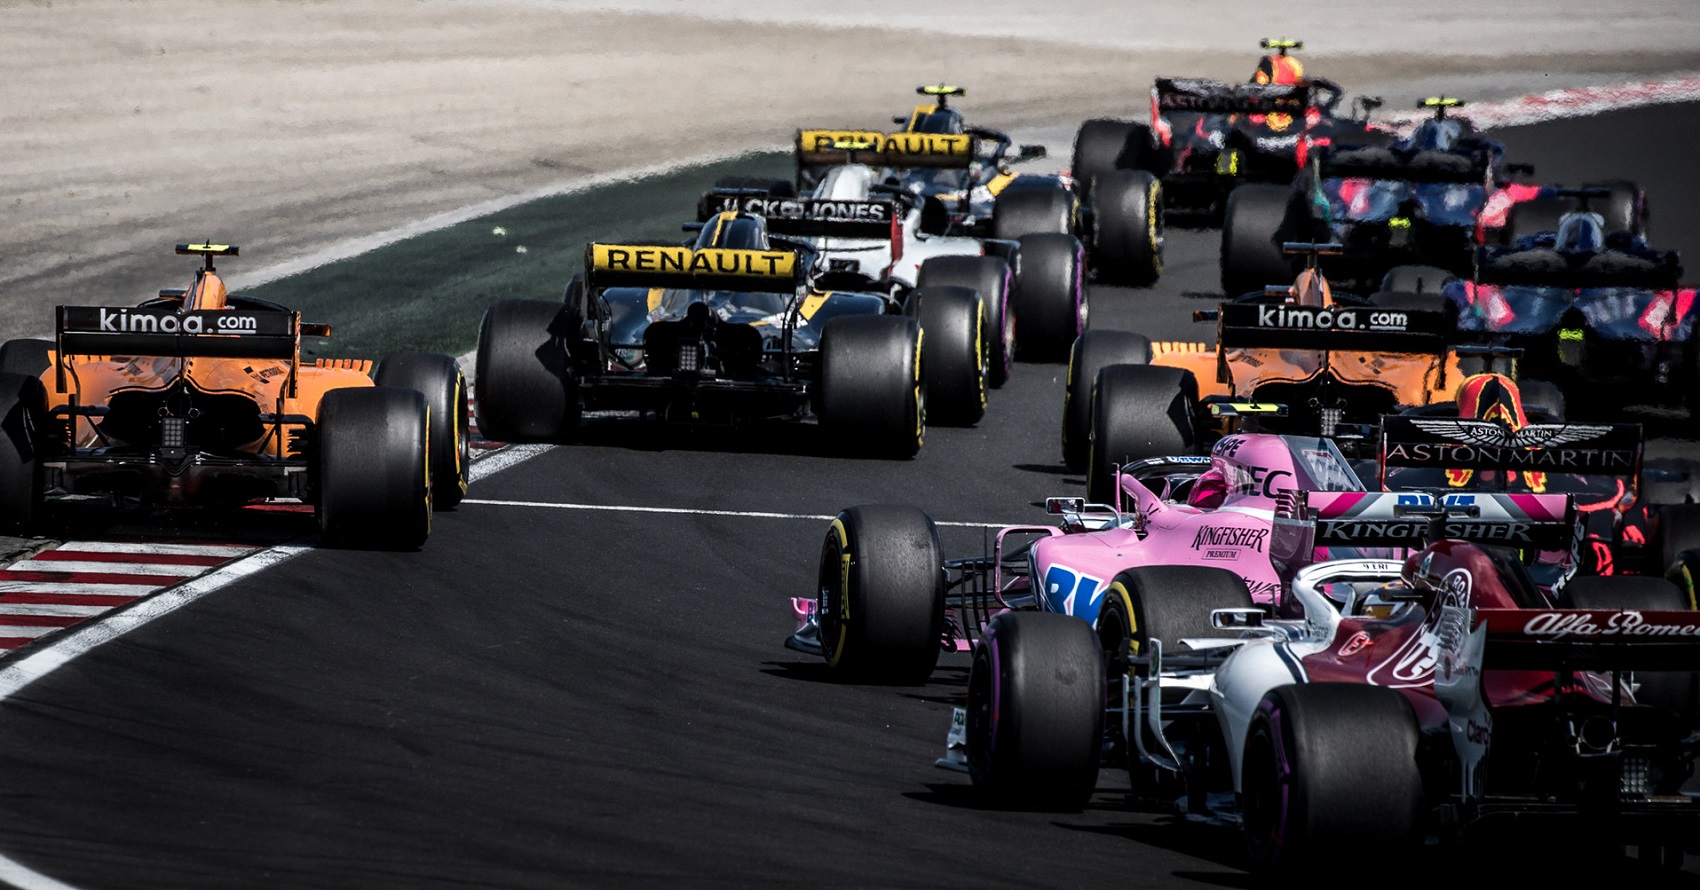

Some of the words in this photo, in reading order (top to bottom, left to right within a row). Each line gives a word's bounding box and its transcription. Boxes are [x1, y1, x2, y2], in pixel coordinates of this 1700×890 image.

[815, 135, 961, 156] RAULT
[607, 249, 785, 276] RENAULT
[1387, 444, 1500, 463] ASTON
[1509, 449, 1635, 467] MARTIN
[1235, 464, 1293, 499] NEC
[1190, 524, 1270, 553] KINGFISHER
[1322, 520, 1534, 543] KINGFSHER
[1205, 550, 1238, 560] PREMIUM
[1523, 612, 1602, 640] Alfa
